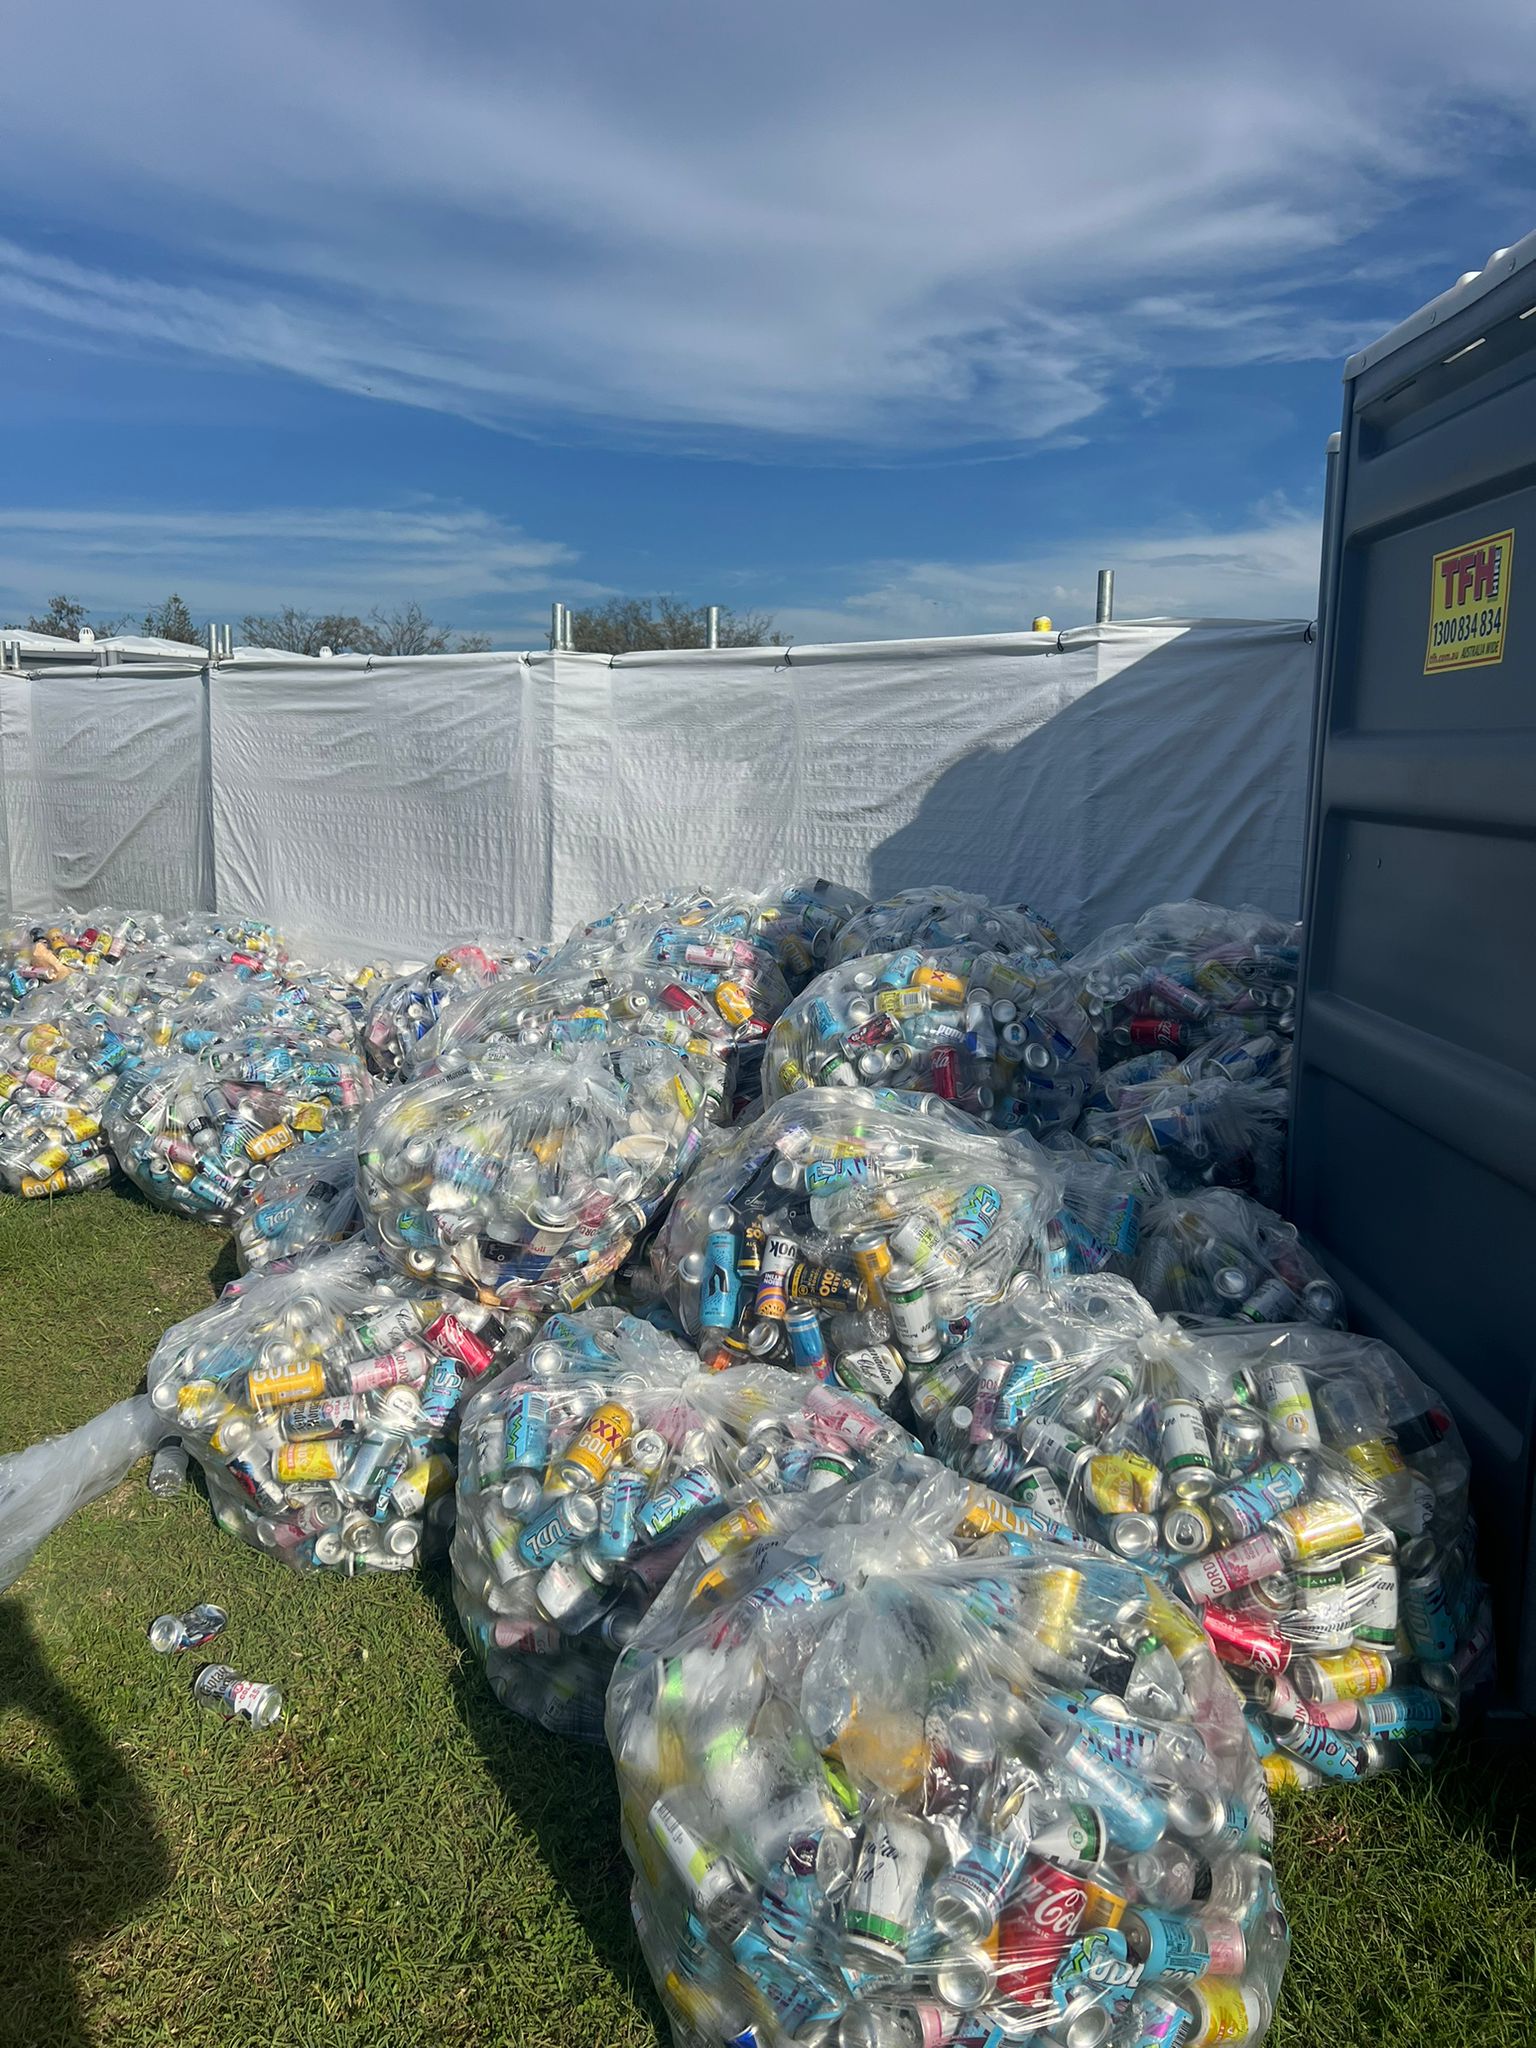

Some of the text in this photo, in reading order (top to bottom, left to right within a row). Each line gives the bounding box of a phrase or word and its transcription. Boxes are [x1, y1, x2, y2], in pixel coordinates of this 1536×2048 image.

[1441, 545, 1497, 609] TFH
[1433, 606, 1502, 647] 1300 834 834
[254, 1130, 289, 1155] GOLD
[26, 1180, 60, 1198] GOLD
[252, 1361, 311, 1383] GOLD
[867, 1348, 894, 1385] anadian
[578, 1434, 614, 1467] GOLD
[526, 1518, 565, 1556] UDL
[1203, 1558, 1228, 1594] GORD
[1087, 1954, 1145, 1989] UDL
